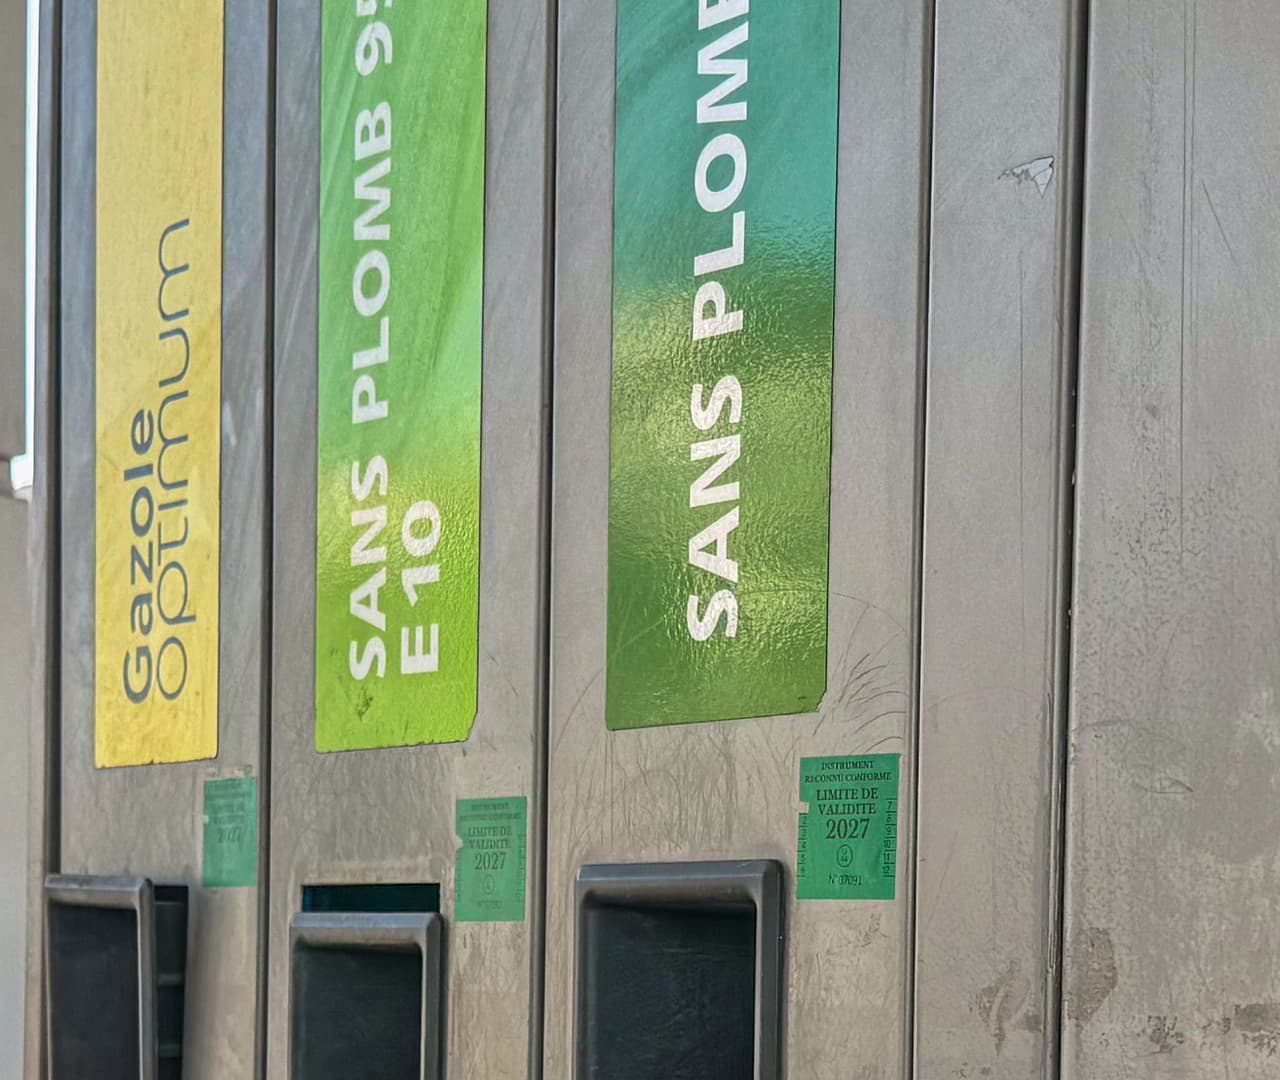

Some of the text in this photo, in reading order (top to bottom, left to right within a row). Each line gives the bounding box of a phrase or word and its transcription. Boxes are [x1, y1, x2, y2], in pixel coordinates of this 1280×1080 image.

[352, 101, 392, 424] PLOMB
[123, 408, 154, 704] Gazole
[348, 455, 388, 681] SANS
[400, 500, 442, 675] E 10
[687, 375, 743, 641] SANS
[474, 851, 507, 871] 2027
[816, 787, 879, 801] LIMITE DE
[826, 818, 870, 839] 2027
